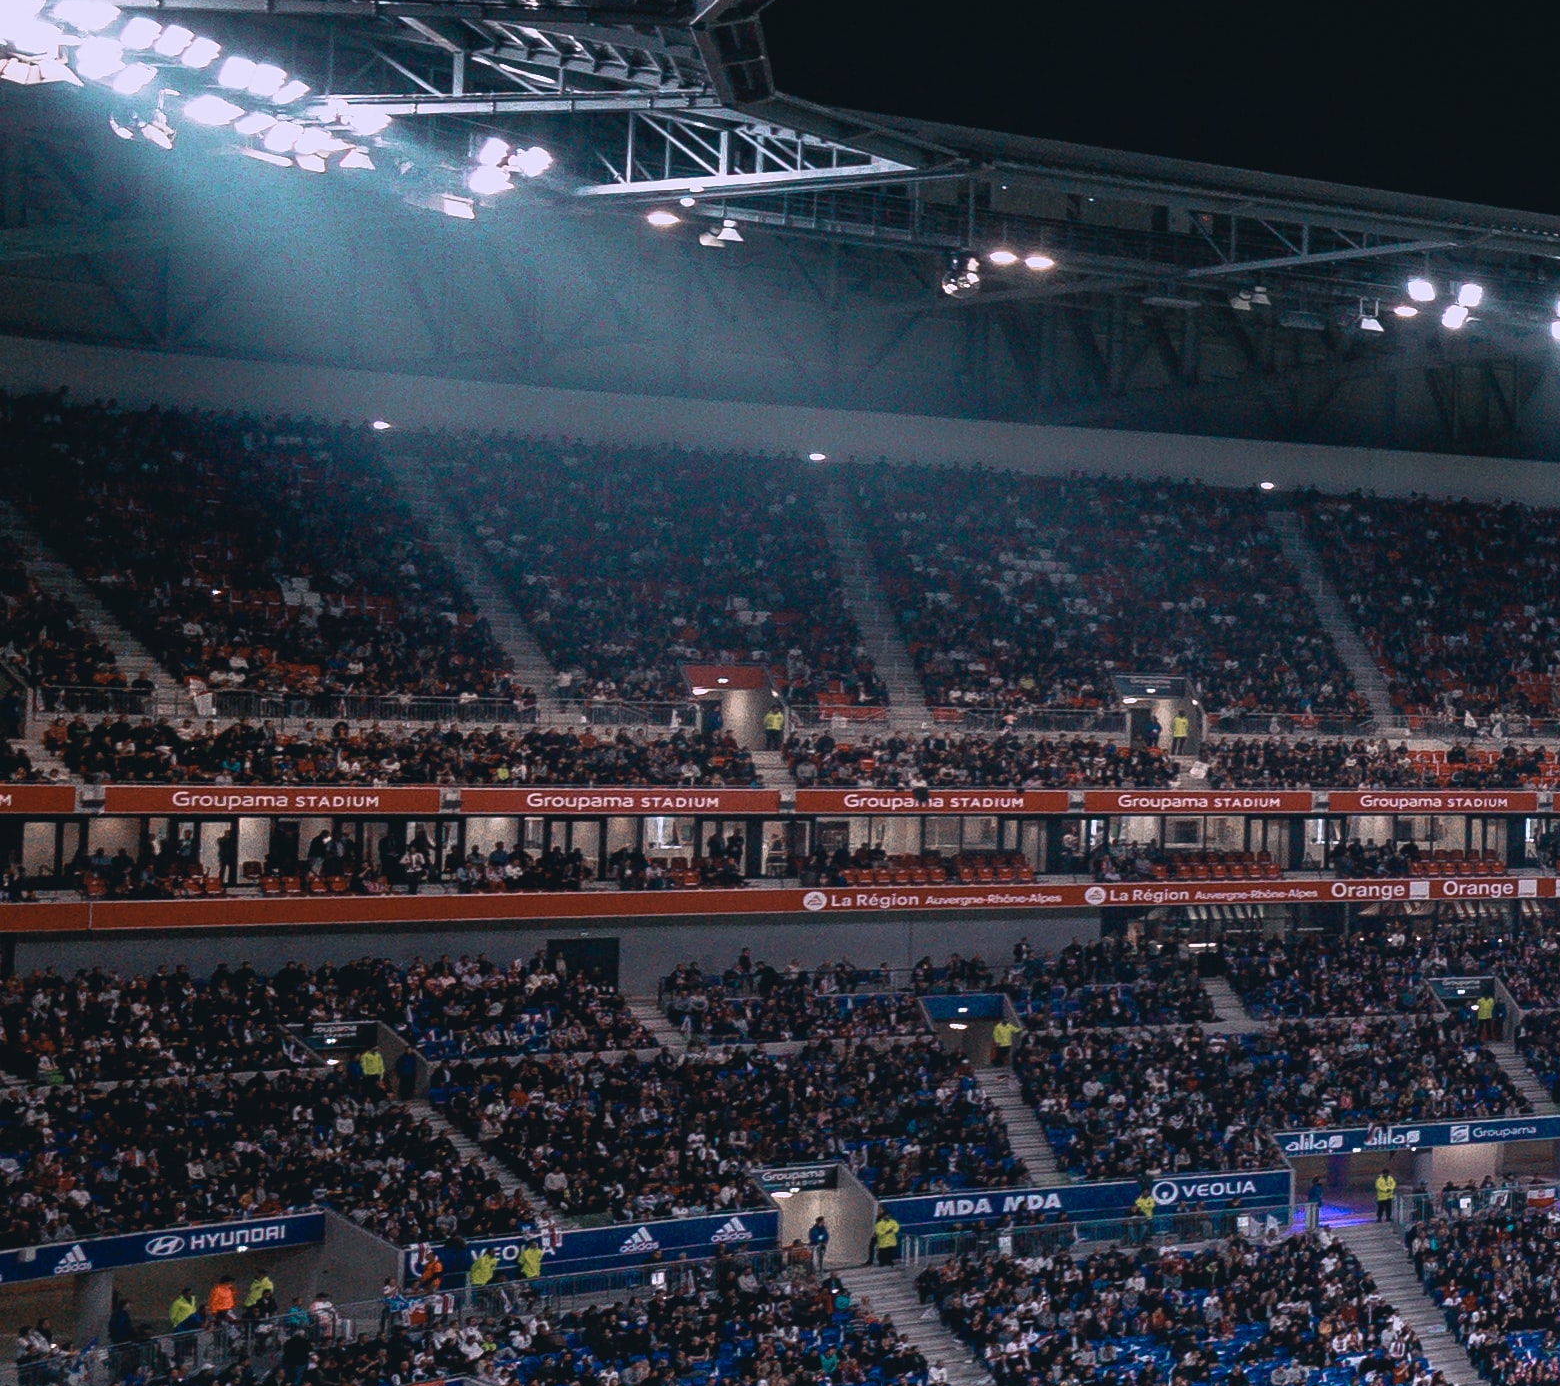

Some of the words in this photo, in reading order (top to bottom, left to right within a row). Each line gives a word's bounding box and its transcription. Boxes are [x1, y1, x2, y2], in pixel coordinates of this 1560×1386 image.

[172, 792, 288, 809] Groupama
[295, 796, 380, 808] STADIUM
[526, 793, 634, 809] Groupama
[640, 797, 720, 808] STADIUM
[950, 797, 1024, 808] STADIUM
[1118, 794, 1208, 809] Groupama
[1213, 797, 1280, 808] STADIUM
[1360, 795, 1441, 809] Groupama
[1447, 798, 1508, 808] STADIUM
[1110, 890, 1127, 901] La
[1133, 887, 1189, 903] Région
[1195, 887, 1317, 901] Auvergne-Rhône-Alpes
[1331, 882, 1405, 900] Orange
[1443, 880, 1513, 898] Orange
[830, 895, 851, 906] La
[857, 893, 919, 908] Région
[926, 893, 1062, 906] Auvergne-Rhône-Alpes
[1472, 1124, 1536, 1139] Groupama
[1182, 1180, 1256, 1197] VEOLIA
[934, 1198, 991, 1217] MDA
[190, 1226, 286, 1249] HYUNDAI
